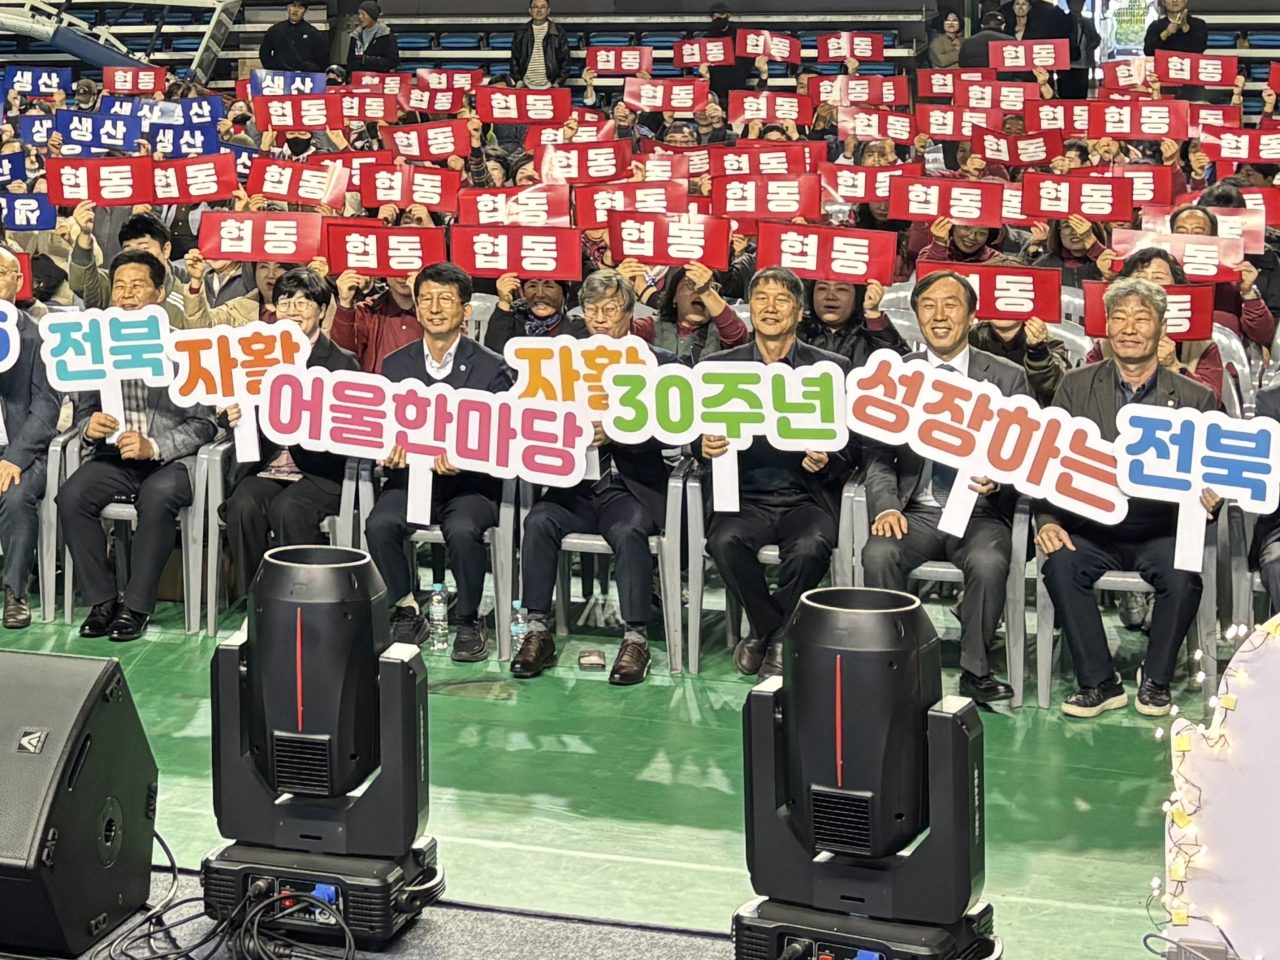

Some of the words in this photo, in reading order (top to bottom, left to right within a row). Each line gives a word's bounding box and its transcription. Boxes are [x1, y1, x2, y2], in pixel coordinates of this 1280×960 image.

[48, 315, 165, 381] 전북
[175, 330, 300, 397] 자활
[267, 373, 583, 477] 어울한마당
[612, 372, 838, 440] 30주년
[852, 359, 1117, 513] 성장하는
[1127, 415, 1272, 502] 전북
